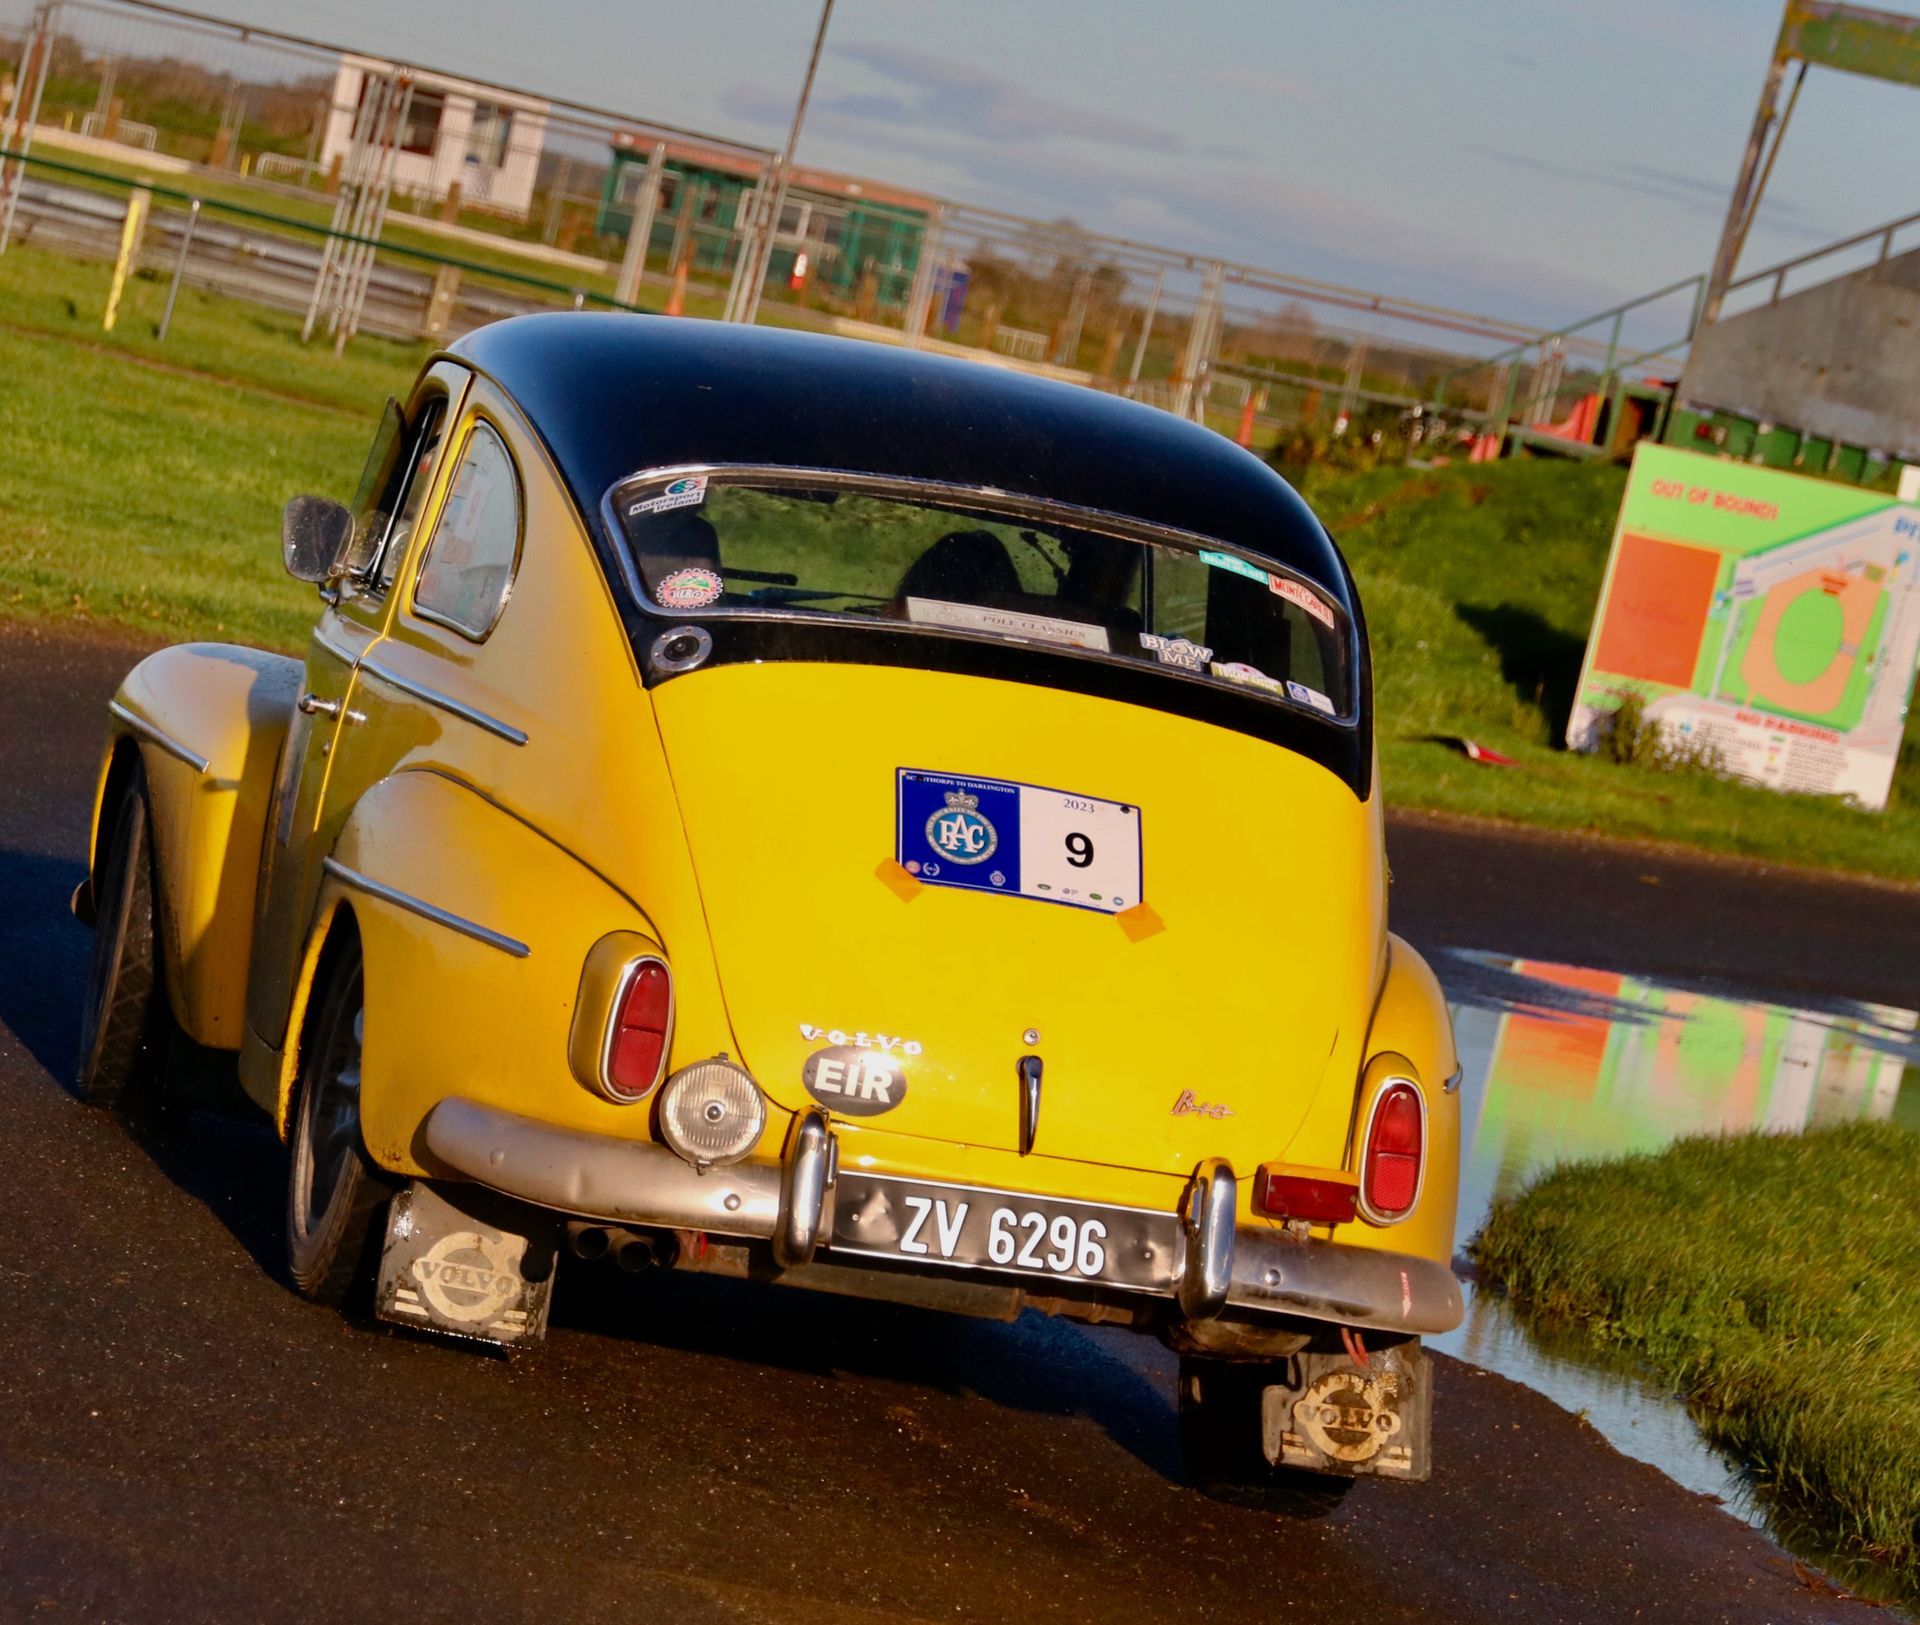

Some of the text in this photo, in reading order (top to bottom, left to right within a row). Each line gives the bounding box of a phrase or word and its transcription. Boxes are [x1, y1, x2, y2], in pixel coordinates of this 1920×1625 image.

[632, 491, 701, 513] Motorsport
[1652, 478, 1684, 500] OUT
[1689, 487, 1709, 504] OF
[656, 498, 700, 512] Ireland
[672, 589, 704, 599] HERO
[1022, 622, 1087, 639] CLASSICS
[1144, 635, 1210, 661] BLOW
[1163, 650, 1198, 669] ME
[906, 775, 955, 786] SCTHORPE
[967, 781, 1016, 794] DARLINGTON
[1063, 798, 1095, 814] 2023
[939, 814, 985, 853] RAC
[1065, 832, 1094, 868] 9
[800, 1024, 922, 1055] VOLVO
[814, 1057, 893, 1104] EIR
[899, 1196, 1107, 1276] ZV 6296
[421, 1260, 513, 1295] VOLVO
